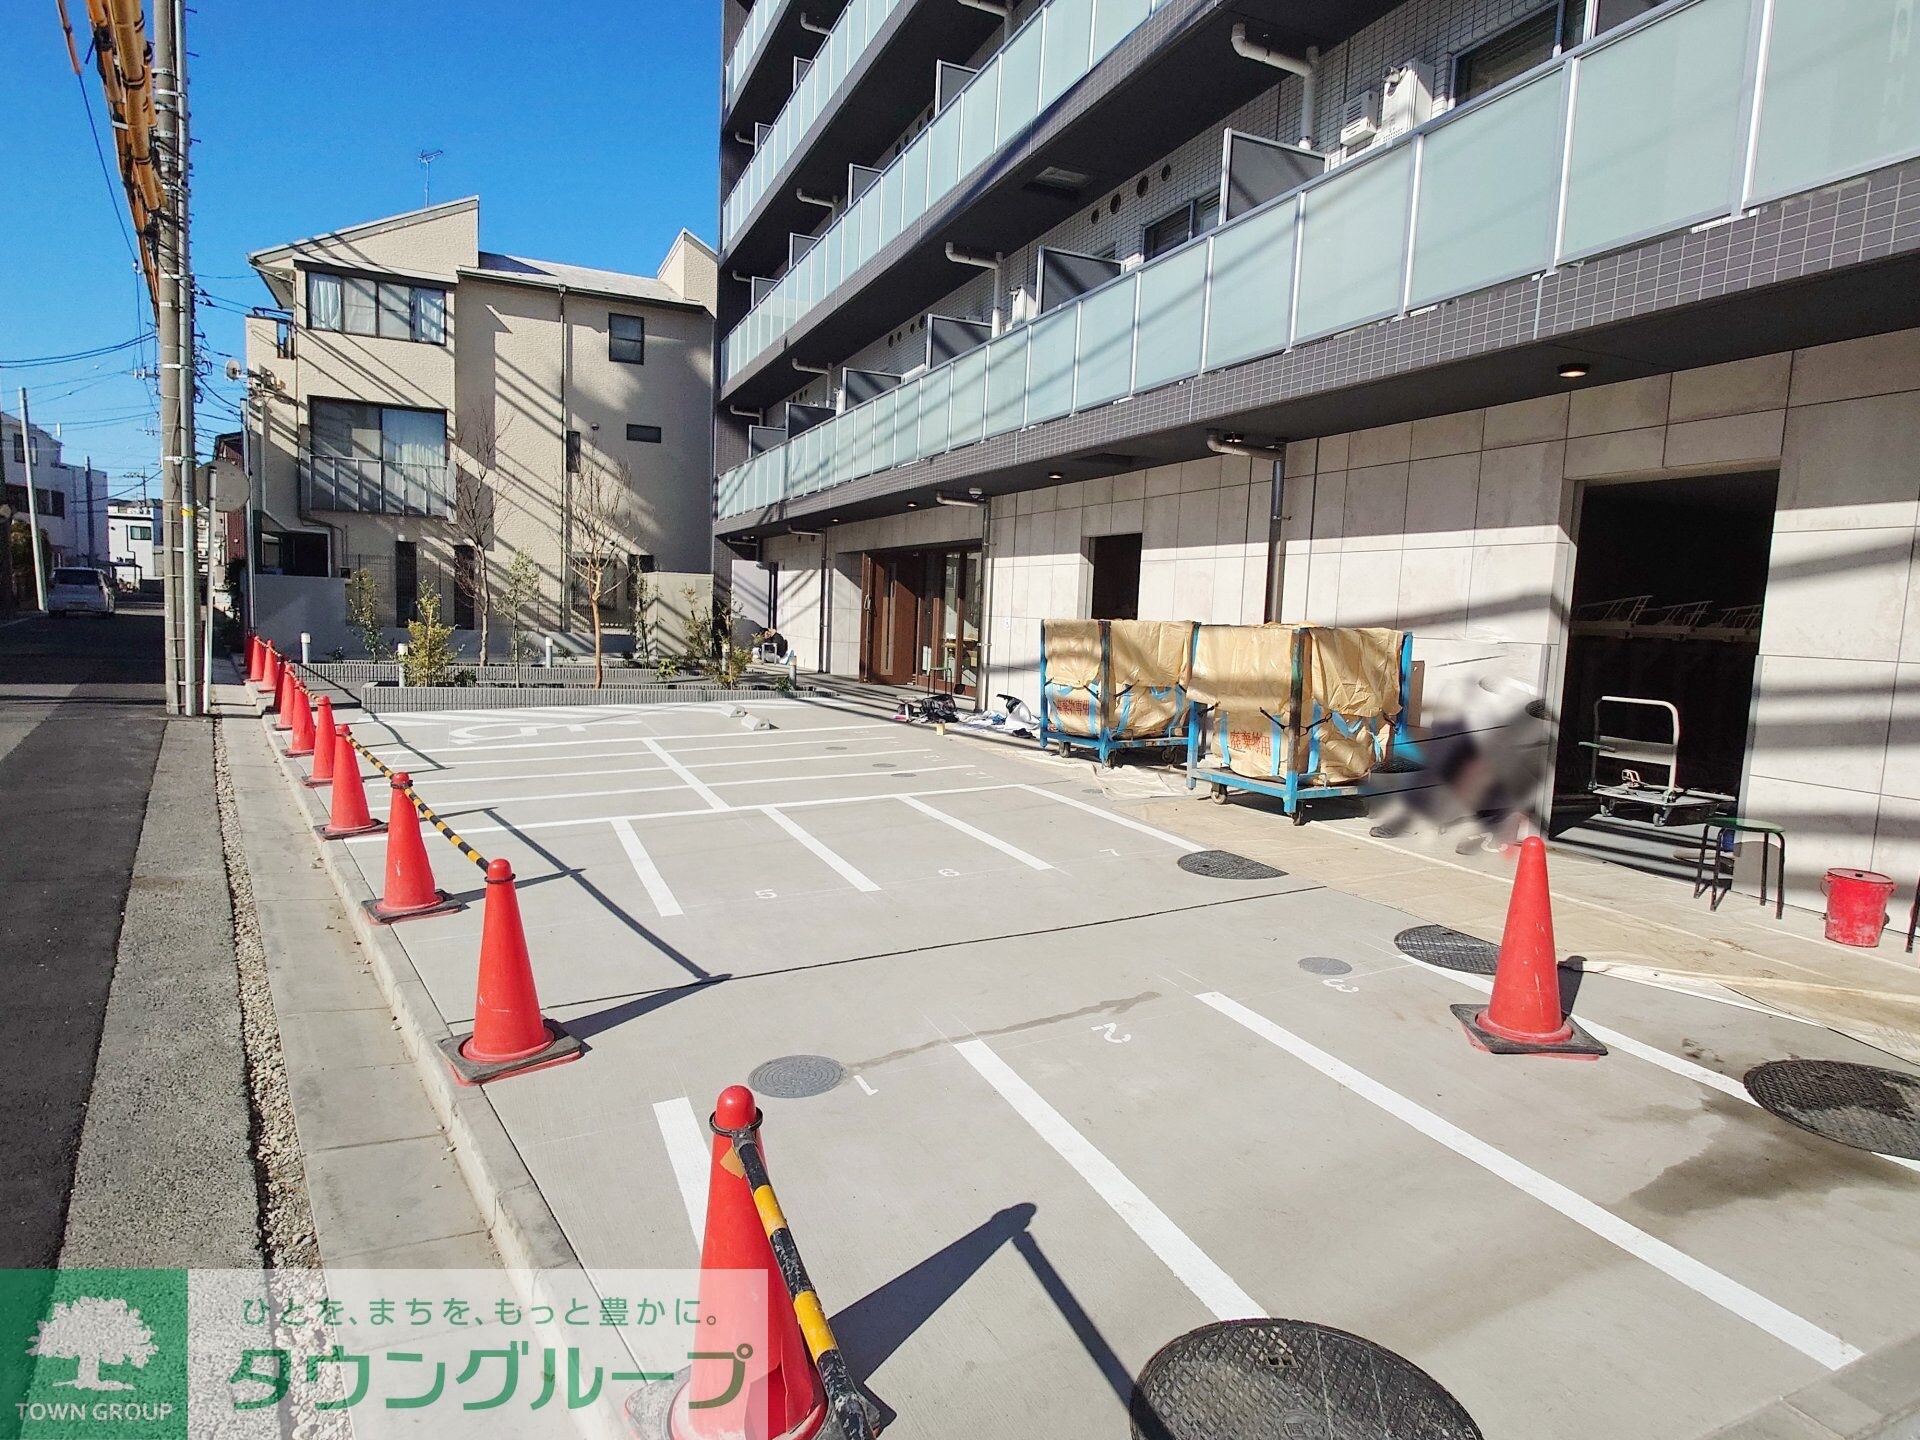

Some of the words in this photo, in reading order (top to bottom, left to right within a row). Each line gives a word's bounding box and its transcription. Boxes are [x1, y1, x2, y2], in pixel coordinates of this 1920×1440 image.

[1098, 848, 1120, 857] 7
[938, 868, 960, 877] 6
[754, 889, 778, 899] 5
[1321, 978, 1360, 993] 3
[1090, 1022, 1132, 1044] 2
[853, 1074, 879, 1096] 1
